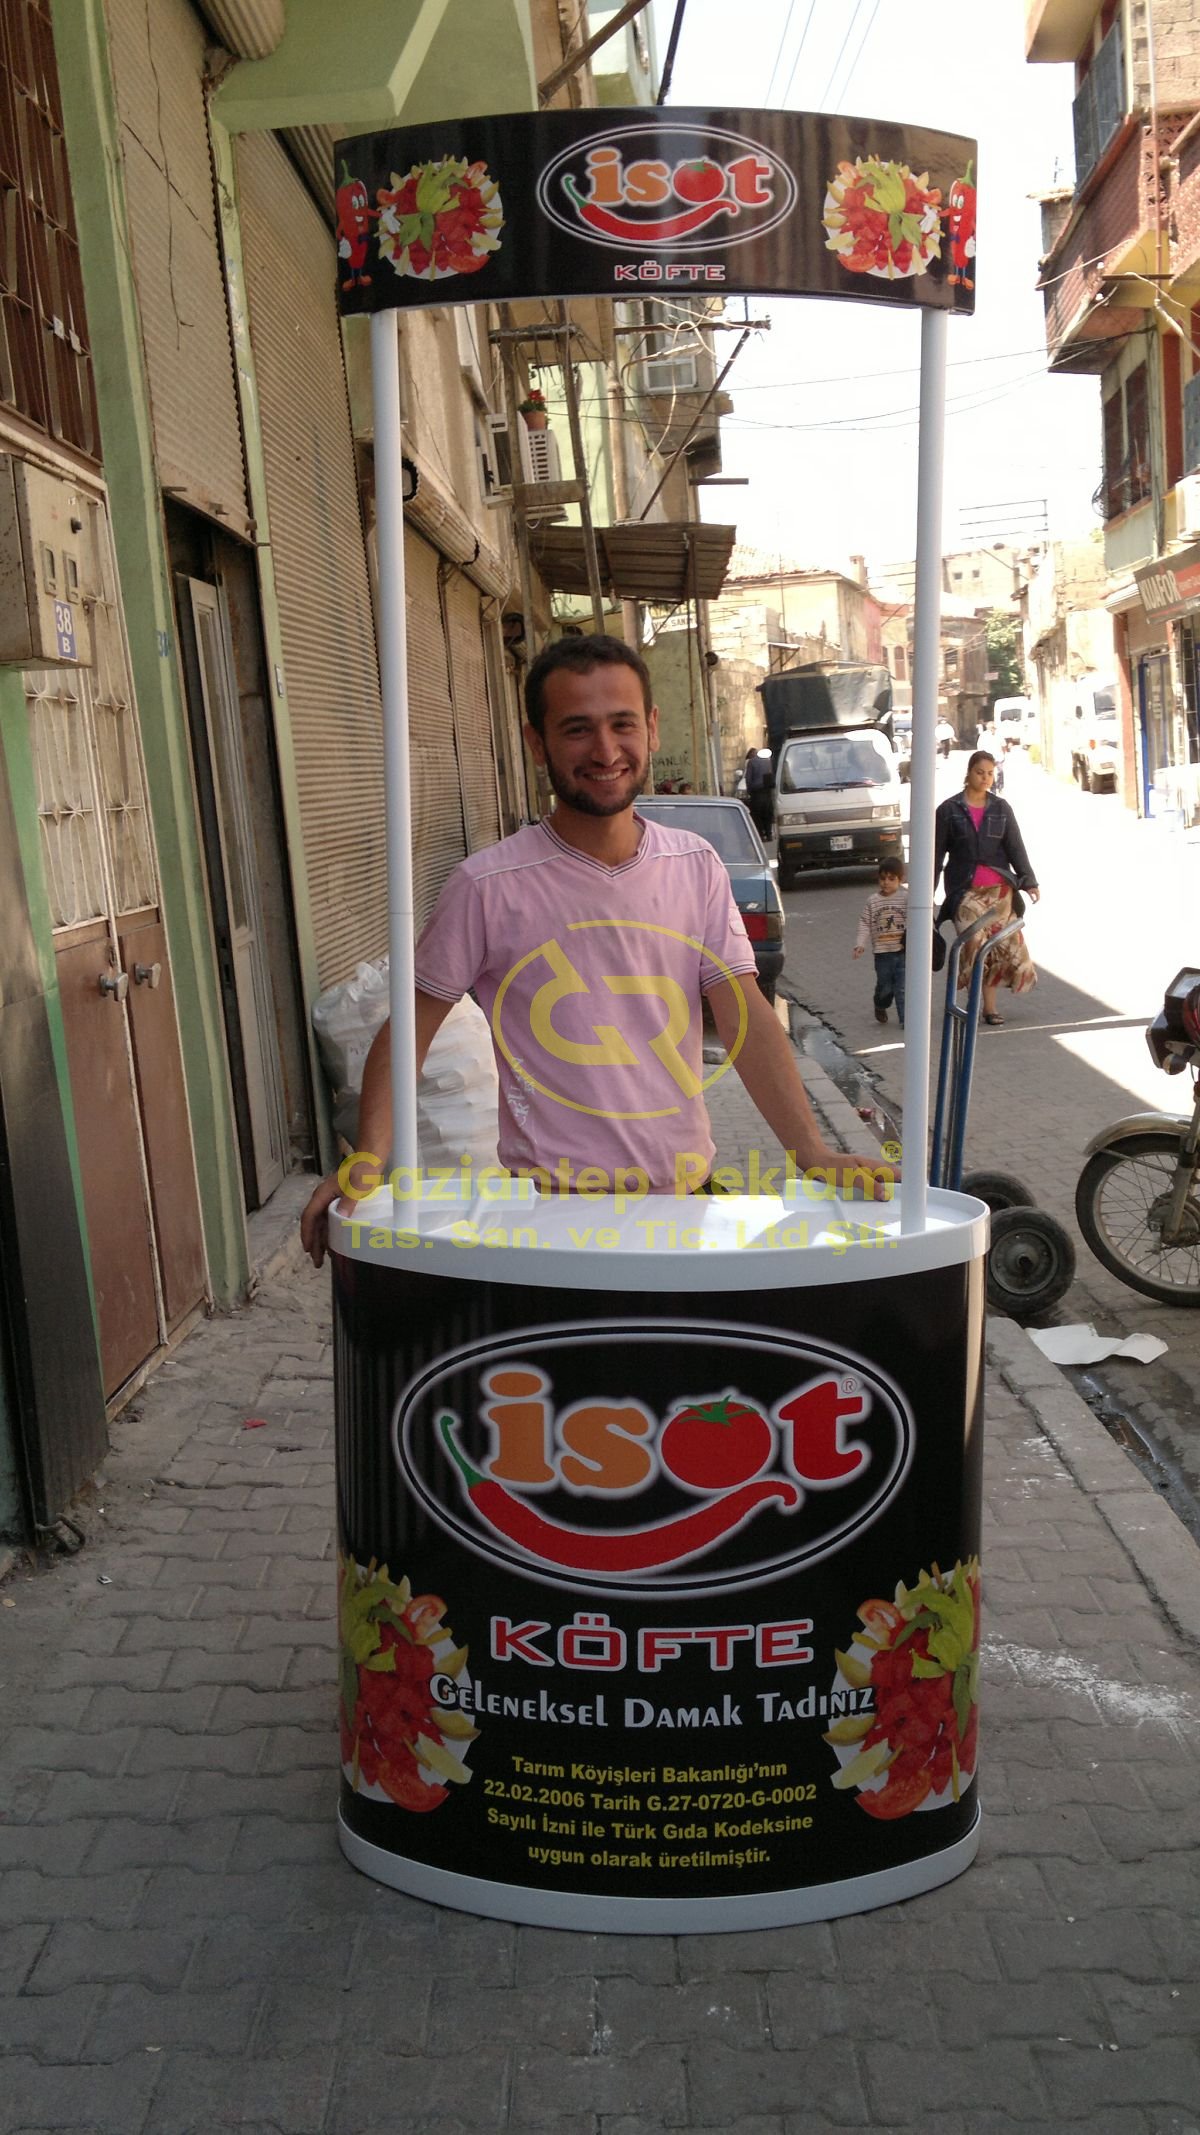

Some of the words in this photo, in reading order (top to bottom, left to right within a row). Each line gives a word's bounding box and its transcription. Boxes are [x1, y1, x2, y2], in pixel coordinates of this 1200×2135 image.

[588, 148, 772, 205] isot
[614, 260, 726, 281] KÖFTE
[55, 605, 72, 635] 38
[62, 636, 70, 653] B
[484, 1368, 868, 1493] isot
[490, 1612, 814, 1673] KÖFTE
[511, 1755, 565, 1778] Tarım
[571, 1763, 656, 1786] Köyişleri
[483, 1779, 585, 1808] 22.02.2006
[591, 1793, 641, 1811] Tarih
[646, 1783, 818, 1812] G.27-0720-G-0002
[487, 1807, 536, 1831] Sayılı
[542, 1812, 576, 1836] İzni
[582, 1820, 606, 1837] ile
[611, 1822, 658, 1840] Türk
[662, 1823, 708, 1840] Gıda
[714, 1815, 814, 1838] Kodeksine
[528, 1845, 585, 1865] uygun
[590, 1850, 652, 1868] olarak
[658, 1847, 771, 1869] üretilmiştir.
